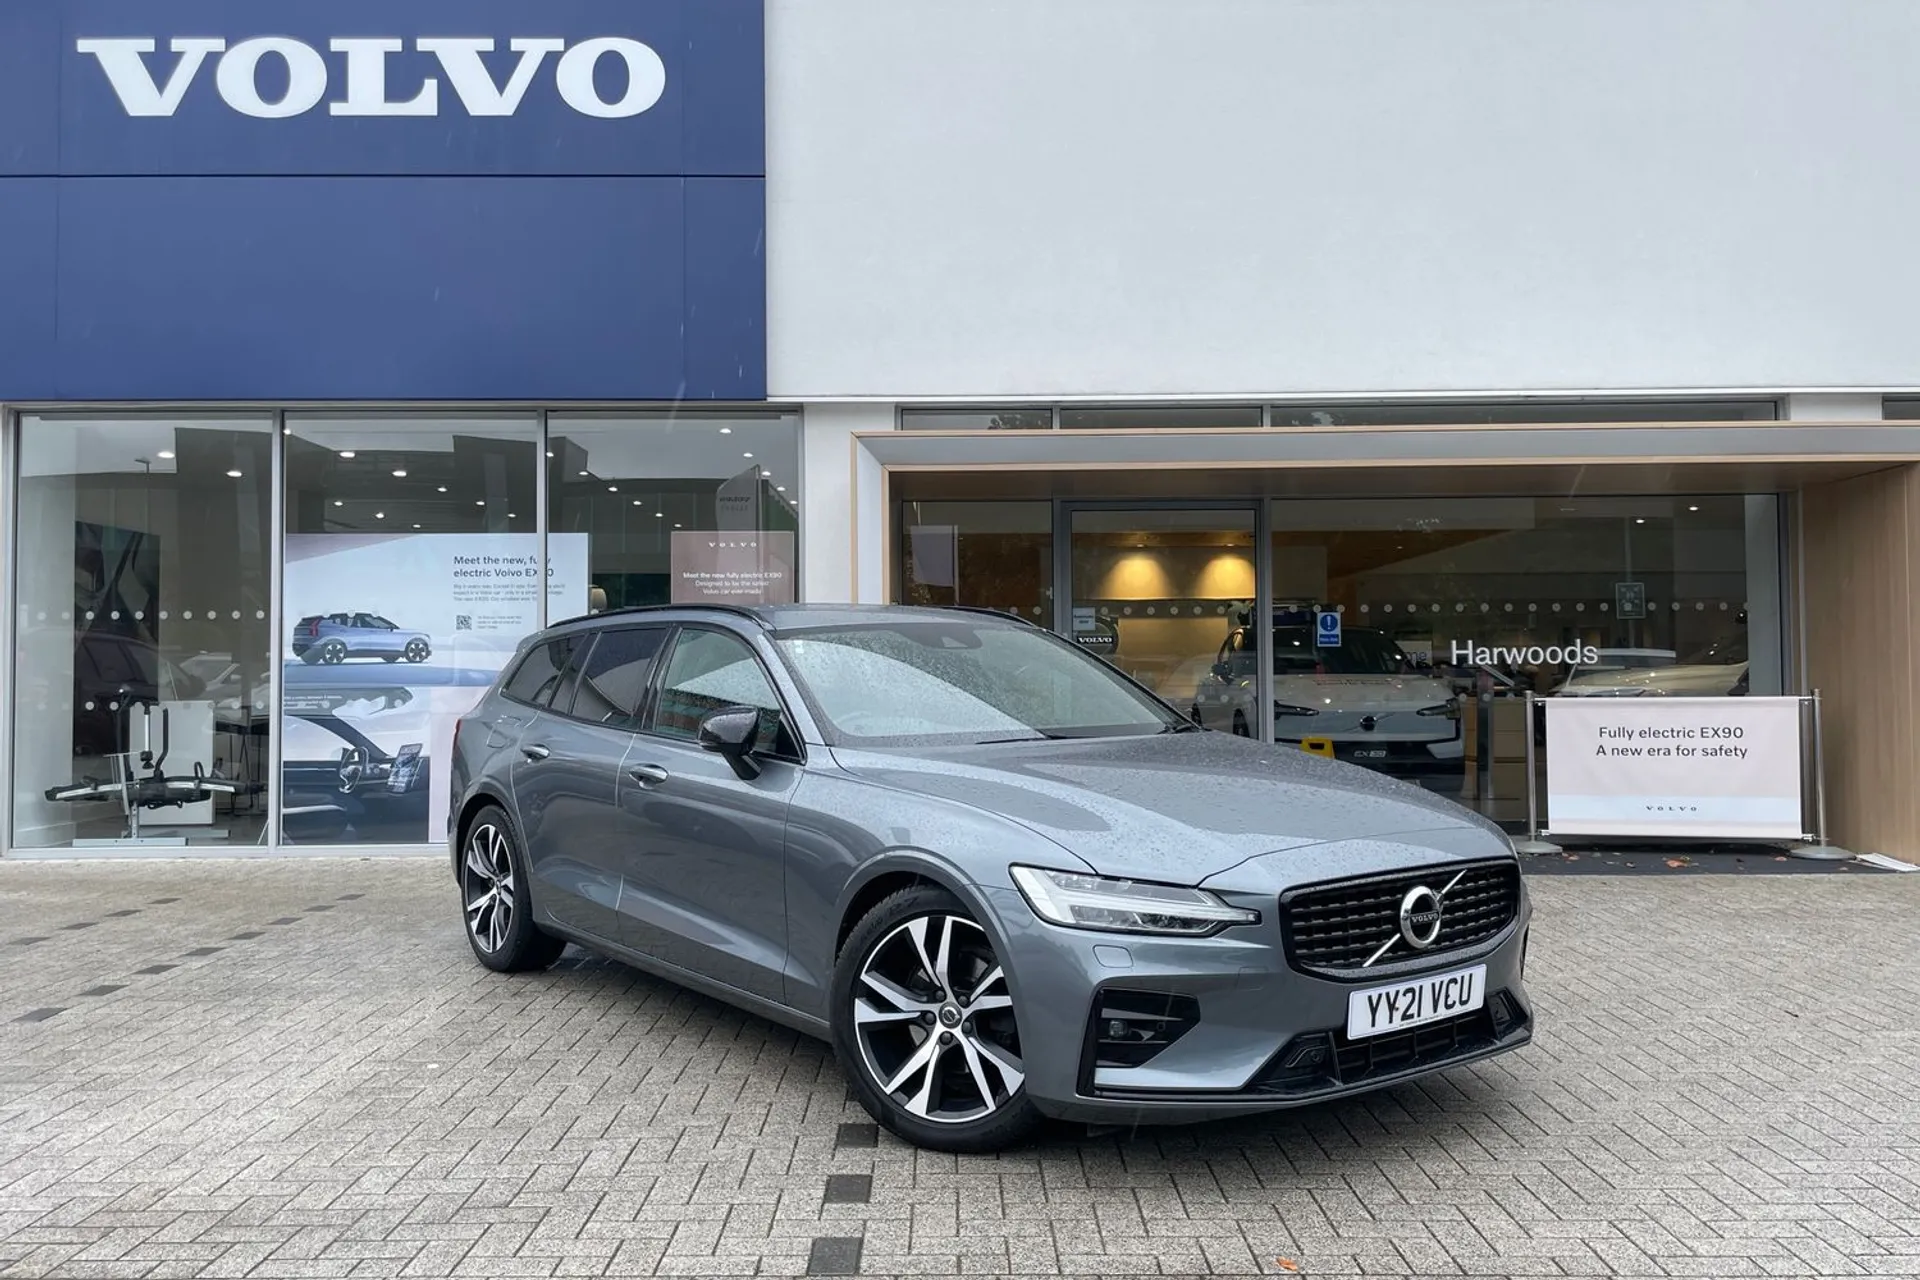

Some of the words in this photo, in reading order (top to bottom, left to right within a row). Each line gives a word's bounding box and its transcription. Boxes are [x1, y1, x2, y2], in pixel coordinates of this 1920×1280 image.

[77, 37, 666, 118] VOLVO
[453, 556, 480, 565] Meet
[483, 555, 501, 565] the
[502, 557, 527, 566] new,
[453, 568, 492, 577] electric
[495, 568, 523, 577] Volvo
[726, 572, 739, 580] fully
[695, 580, 723, 588] Designed
[1451, 638, 1599, 666] Harwoods
[1599, 726, 1635, 741] Fully
[1638, 726, 1696, 739] electric
[1700, 726, 1744, 739] EX90
[1596, 744, 1607, 756] A
[1611, 746, 1643, 756] new
[1647, 746, 1671, 756] era
[1675, 744, 1697, 756] for
[1701, 744, 1748, 759] safety
[1411, 913, 1439, 923] VOLVO
[1367, 985, 1424, 1028] YY21
[1431, 973, 1474, 1014] VCU
